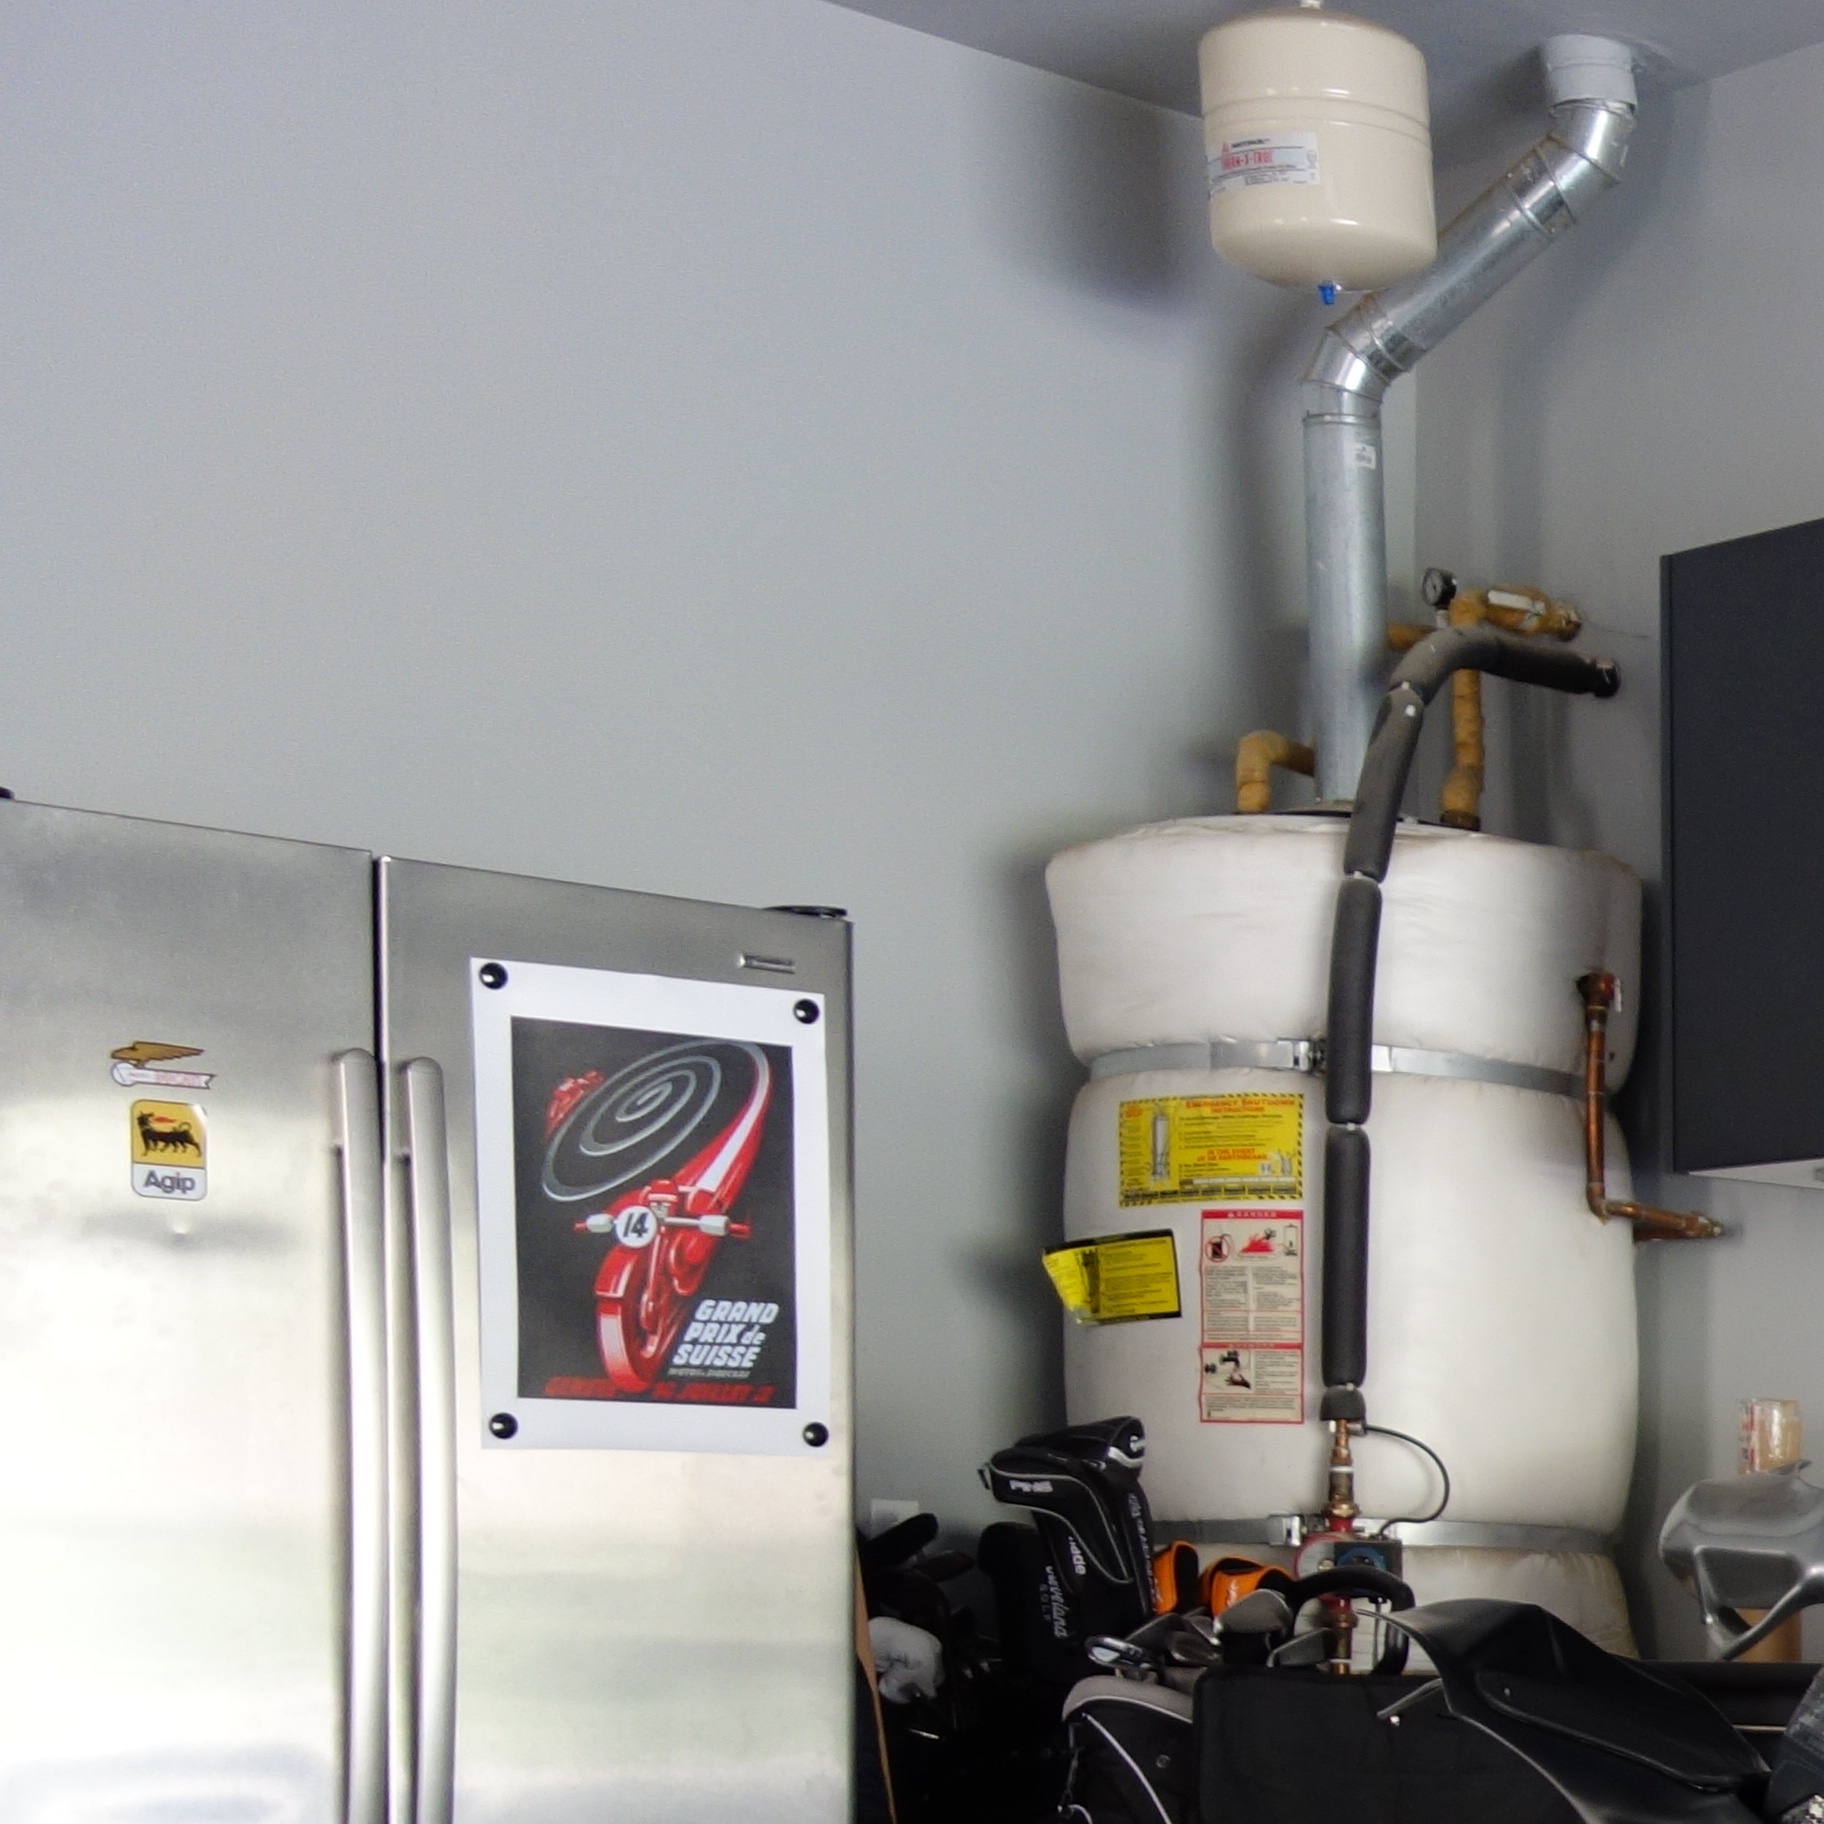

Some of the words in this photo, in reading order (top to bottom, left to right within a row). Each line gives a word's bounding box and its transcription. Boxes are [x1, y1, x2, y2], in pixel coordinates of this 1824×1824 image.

[144, 1169, 196, 1195] Agip
[622, 1211, 650, 1239] 14
[695, 1299, 779, 1324] GRAND
[683, 1321, 741, 1345] PRIX
[740, 1324, 767, 1345] de
[672, 1343, 761, 1368] SUISSE
